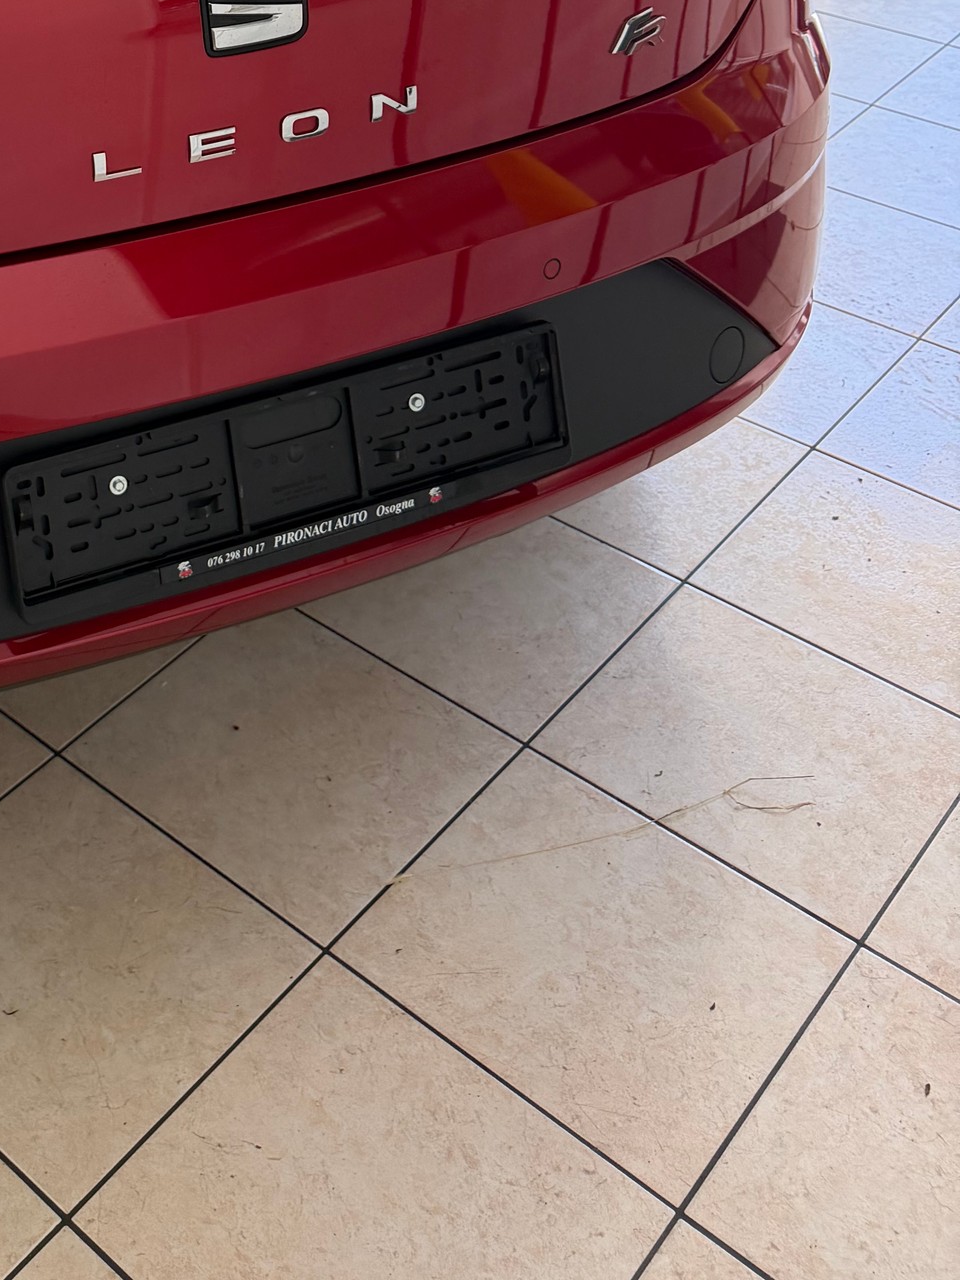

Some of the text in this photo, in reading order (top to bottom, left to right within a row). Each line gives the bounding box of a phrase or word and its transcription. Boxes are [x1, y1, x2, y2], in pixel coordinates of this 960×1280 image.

[92, 85, 418, 182] LEON
[207, 497, 415, 568] 076 298 10 17 PIRONACI AUTO Osogna
